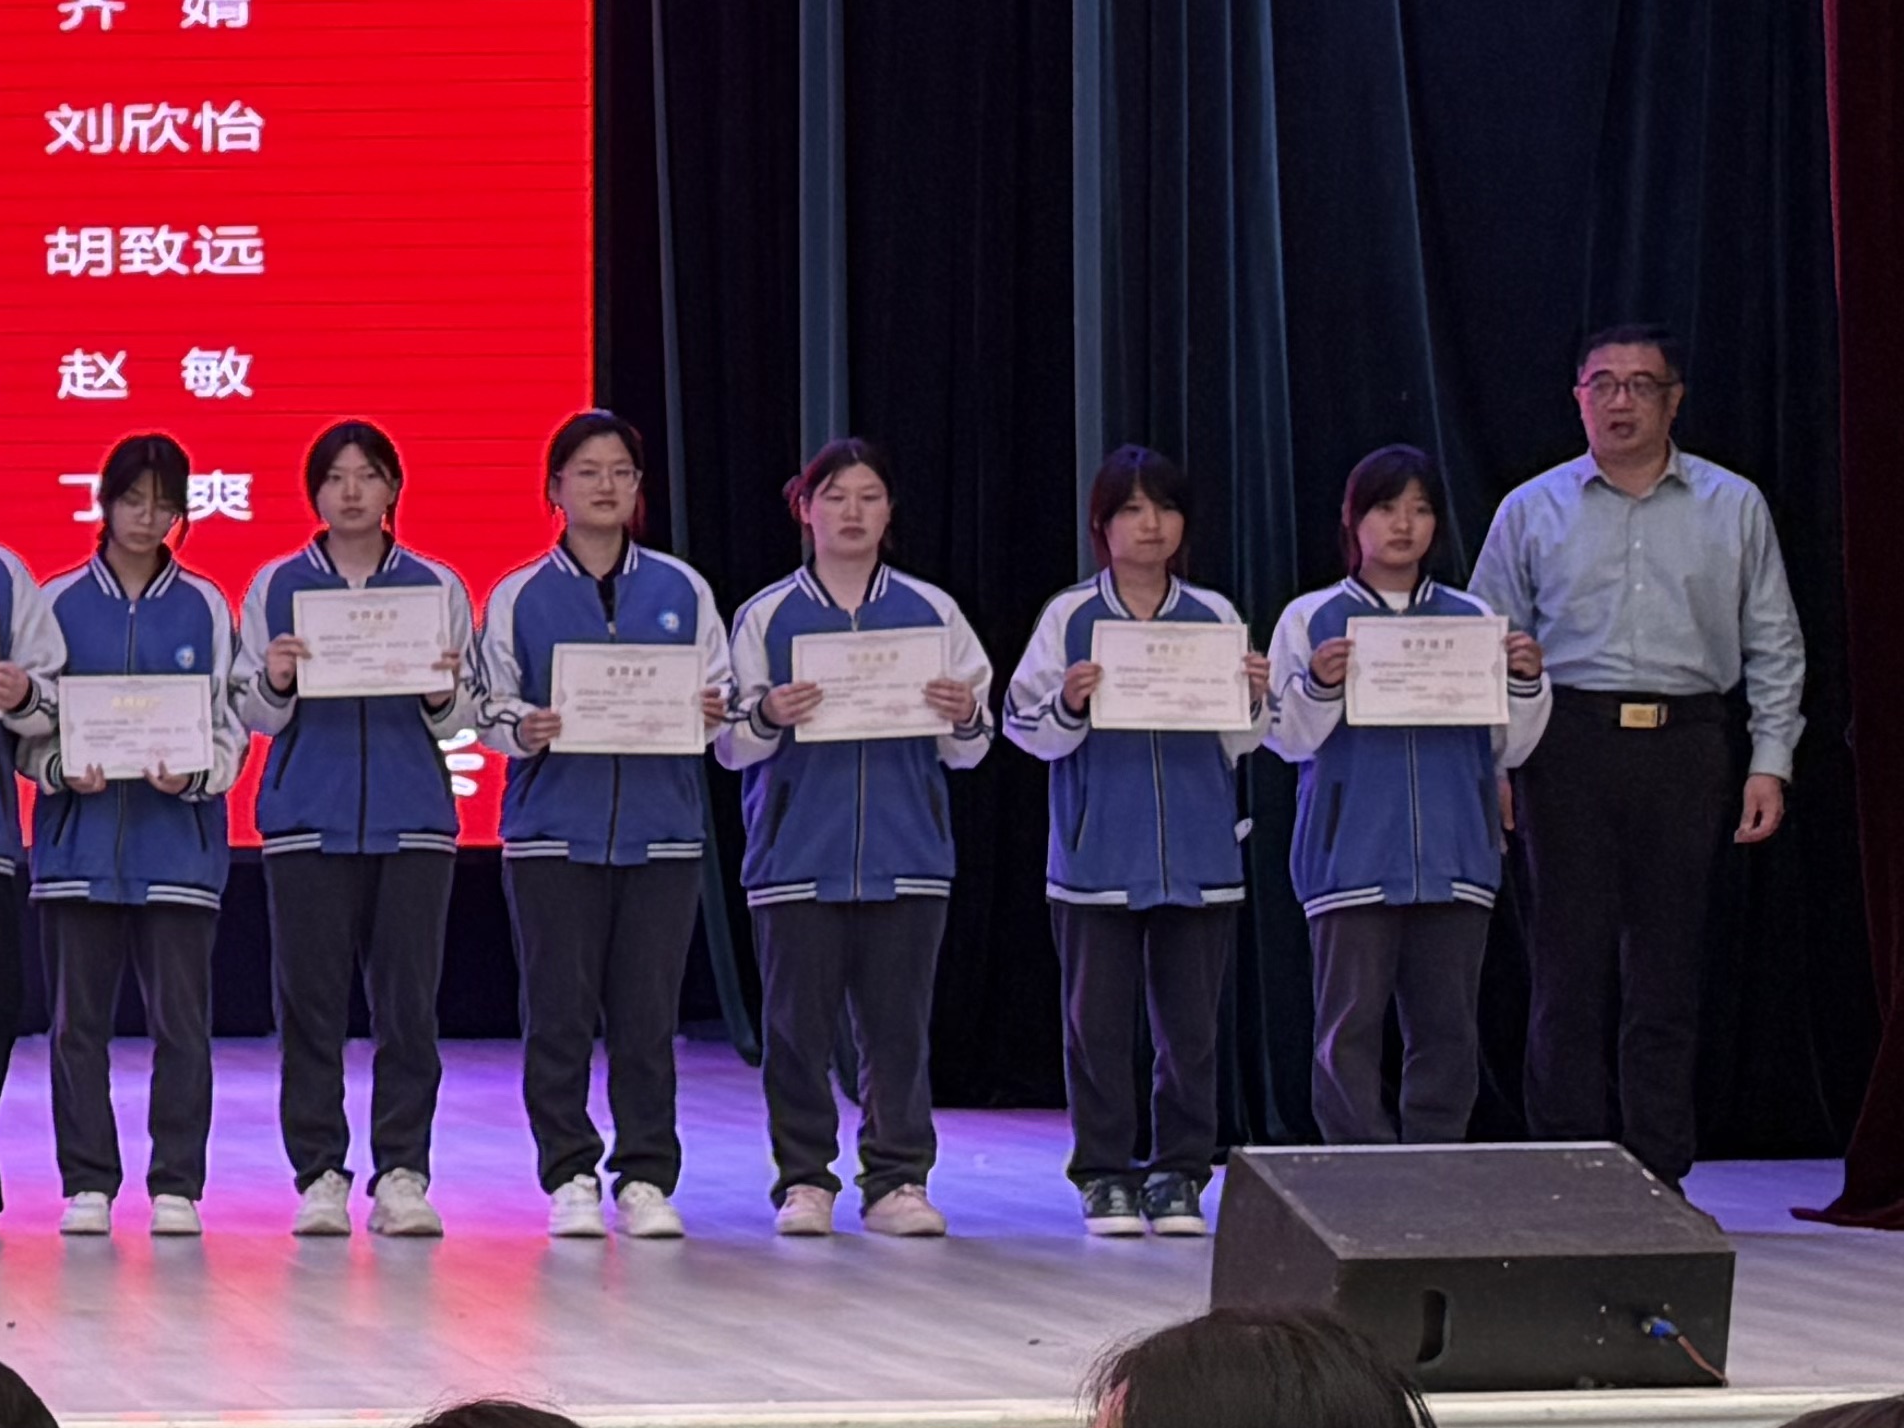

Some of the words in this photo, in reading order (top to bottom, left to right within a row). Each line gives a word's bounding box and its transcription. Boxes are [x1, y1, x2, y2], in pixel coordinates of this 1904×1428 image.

[46, 102, 263, 153] 刘欣怡
[46, 225, 263, 276] 胡致远
